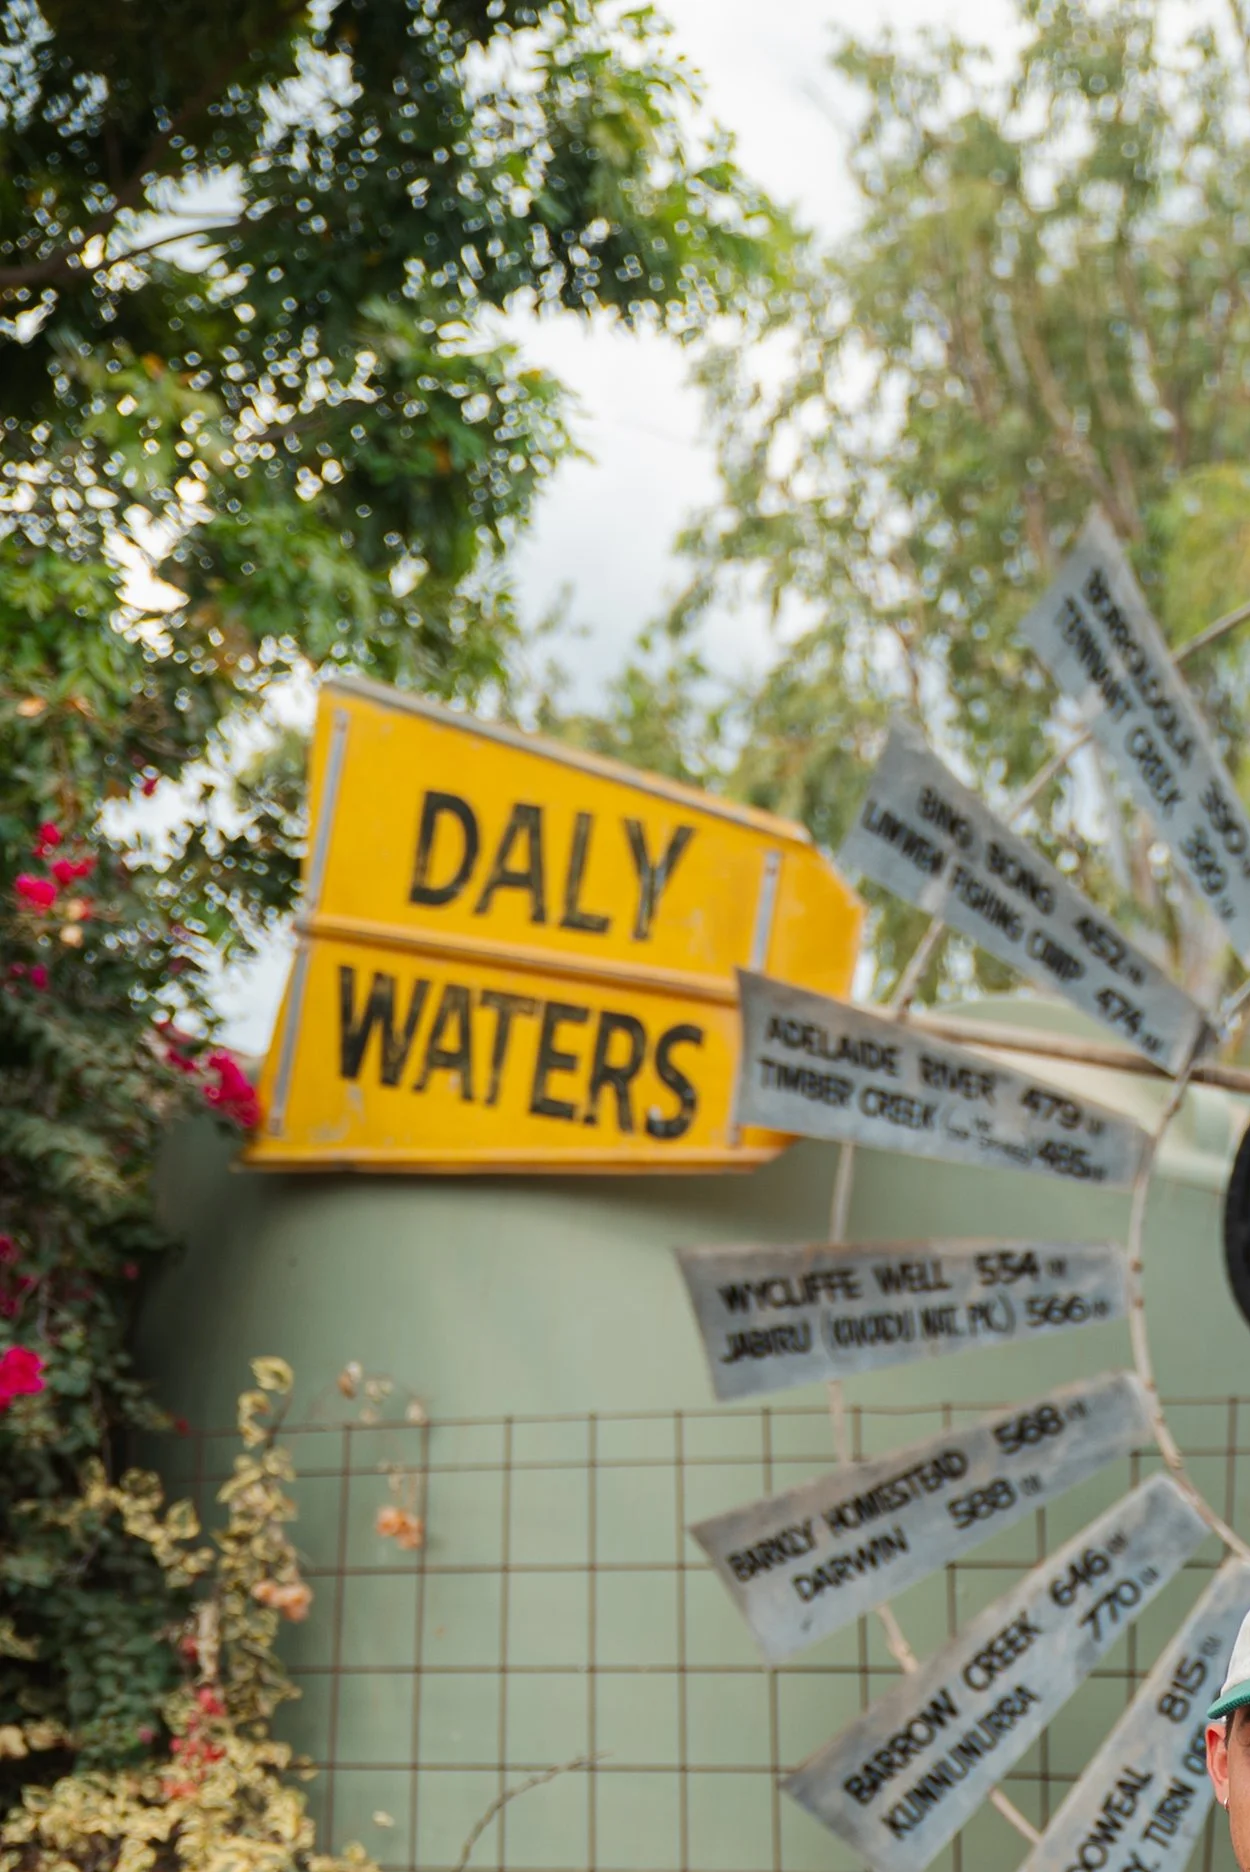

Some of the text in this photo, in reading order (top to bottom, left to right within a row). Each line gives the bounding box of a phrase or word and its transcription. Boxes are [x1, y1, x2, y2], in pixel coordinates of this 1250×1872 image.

[1055, 596, 1136, 719] TENNANT
[1124, 724, 1186, 814] CREEK
[407, 789, 697, 941] DALY
[946, 864, 1028, 942] FISHING
[1091, 984, 1146, 1036] 474
[338, 966, 706, 1140] WATERS
[756, 1057, 854, 1107] TIMBER
[858, 1086, 939, 1130] CREEK
[765, 1015, 901, 1076] ADELAIDE
[915, 1053, 999, 1102] RIVER
[1018, 1086, 1084, 1130] 479
[718, 1268, 860, 1313] WYCLIFFE
[872, 1260, 950, 1295] WELL
[973, 1248, 1040, 1286] 554
[720, 1322, 811, 1364] JABIRU
[1024, 1295, 1087, 1327] 566
[821, 1447, 971, 1535] HOMESTEAD
[990, 1402, 1066, 1456] 568
[790, 1526, 910, 1602] DARWIN
[945, 1476, 1018, 1530] 588
[1076, 1576, 1146, 1643] 770
[838, 1687, 964, 1807] BARROW
[958, 1611, 1042, 1694] CREEK
[1044, 1545, 1113, 1610] 646
[1152, 1654, 1212, 1726] 815
[1139, 1777, 1198, 1848] TURN
